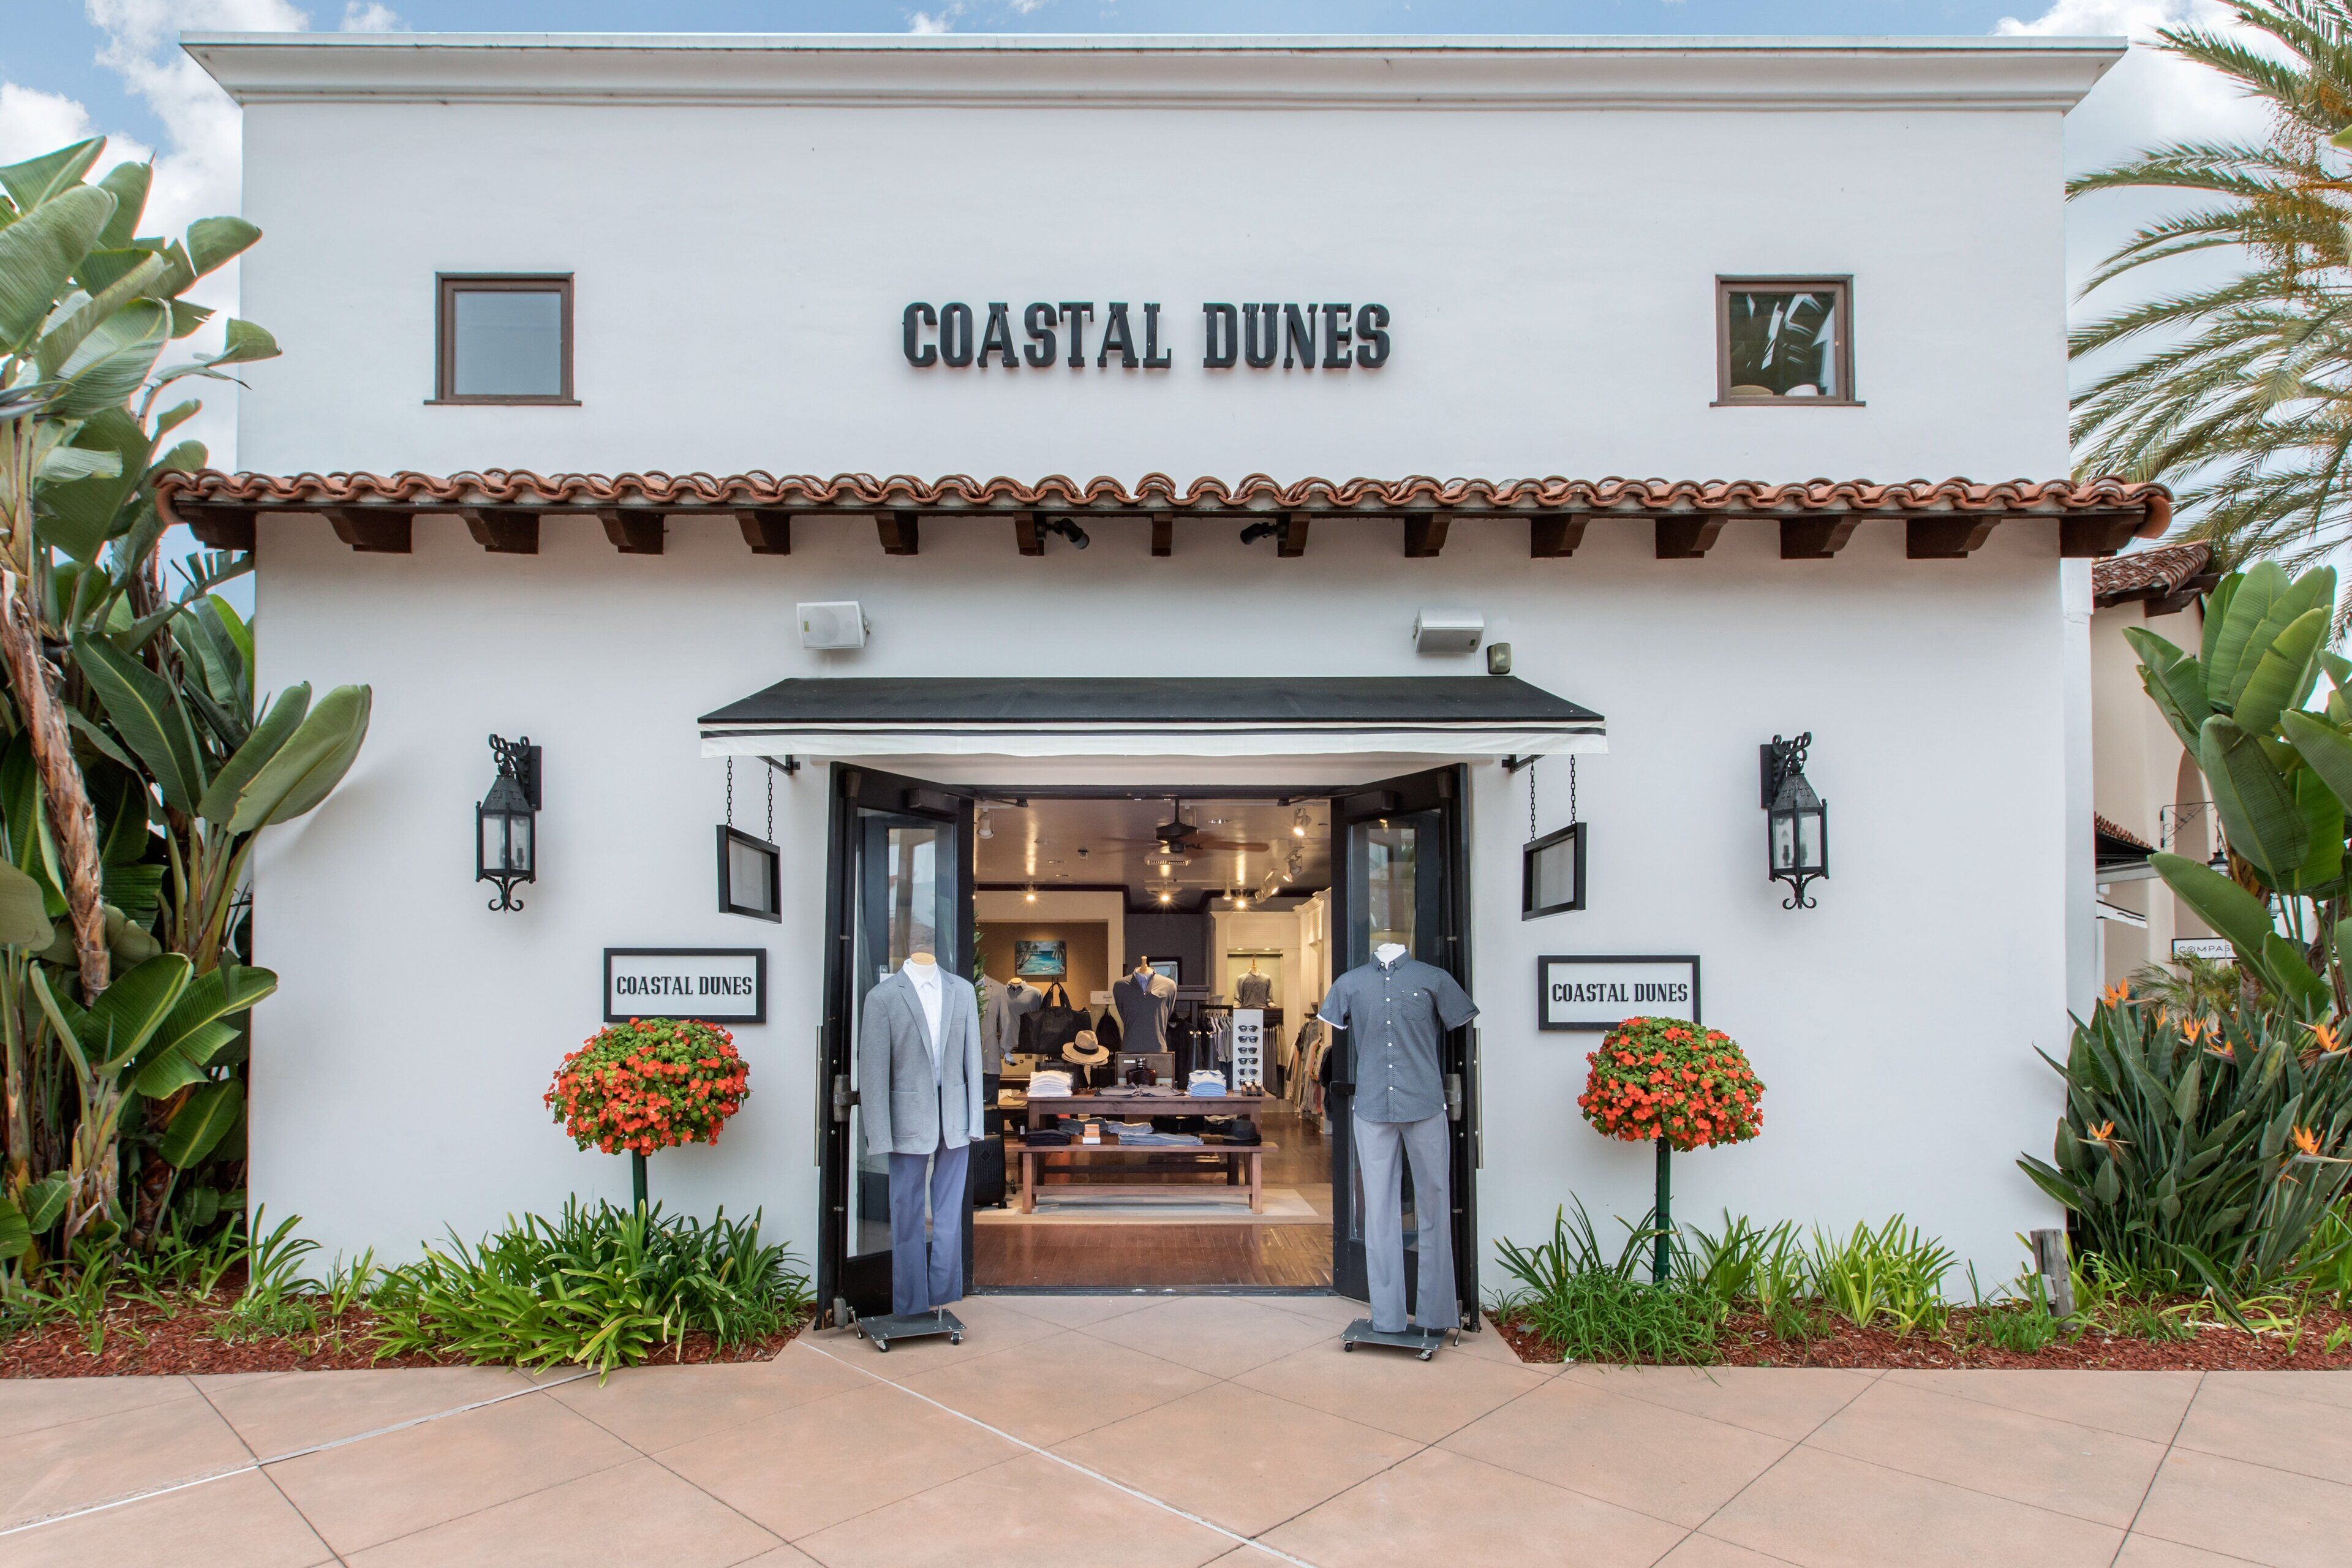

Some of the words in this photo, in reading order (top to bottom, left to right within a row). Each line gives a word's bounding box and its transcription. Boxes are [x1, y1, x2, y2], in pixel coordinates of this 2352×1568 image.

[903, 302, 1172, 369] COASTAL
[1204, 303, 1390, 369] DUNES
[617, 976, 693, 995] COASTAL
[698, 976, 752, 995] DUNES
[1552, 983, 1629, 1002] COASTAL
[1634, 983, 1687, 1002] DUNES
